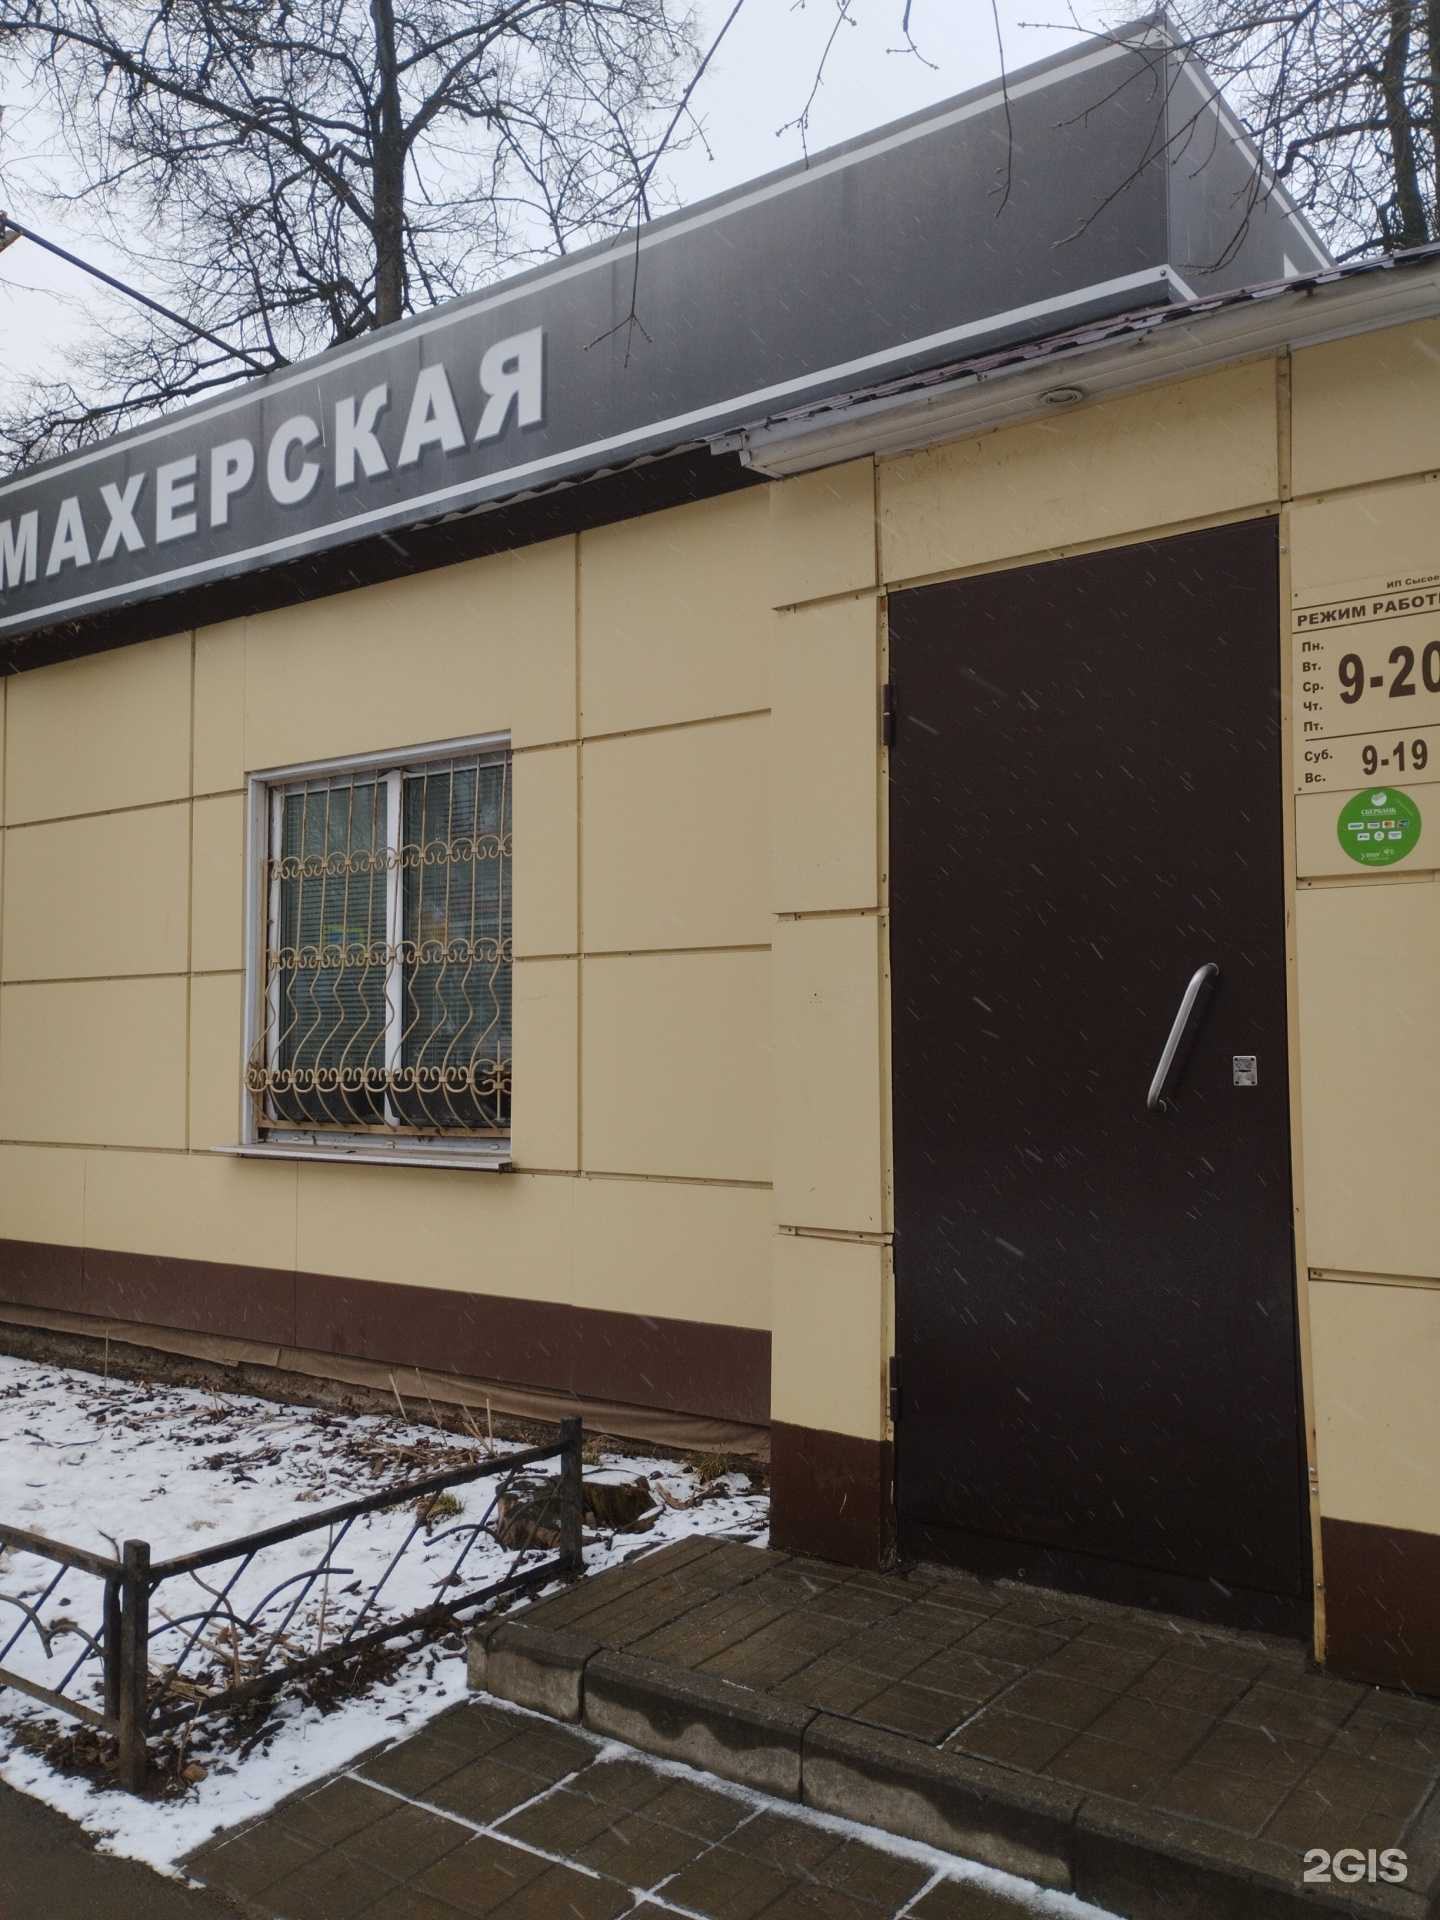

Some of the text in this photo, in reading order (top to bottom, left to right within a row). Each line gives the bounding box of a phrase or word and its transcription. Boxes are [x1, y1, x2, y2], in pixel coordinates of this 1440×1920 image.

[0, 326, 543, 591] МАХЕРСКАЯ
[1386, 580, 1402, 589] ИП
[1297, 592, 1440, 627] РЕЖИМ РАБОТ
[1302, 641, 1325, 653] Пн.
[1302, 661, 1322, 672] Вт.
[1338, 640, 1440, 705] 9-20
[1303, 681, 1324, 694] Ср.
[1303, 701, 1323, 712] Чт.
[1303, 721, 1324, 732] Пт.
[1304, 749, 1333, 764] Суб.
[1361, 738, 1428, 776] 9-19
[1305, 772, 1326, 783] Вс.
